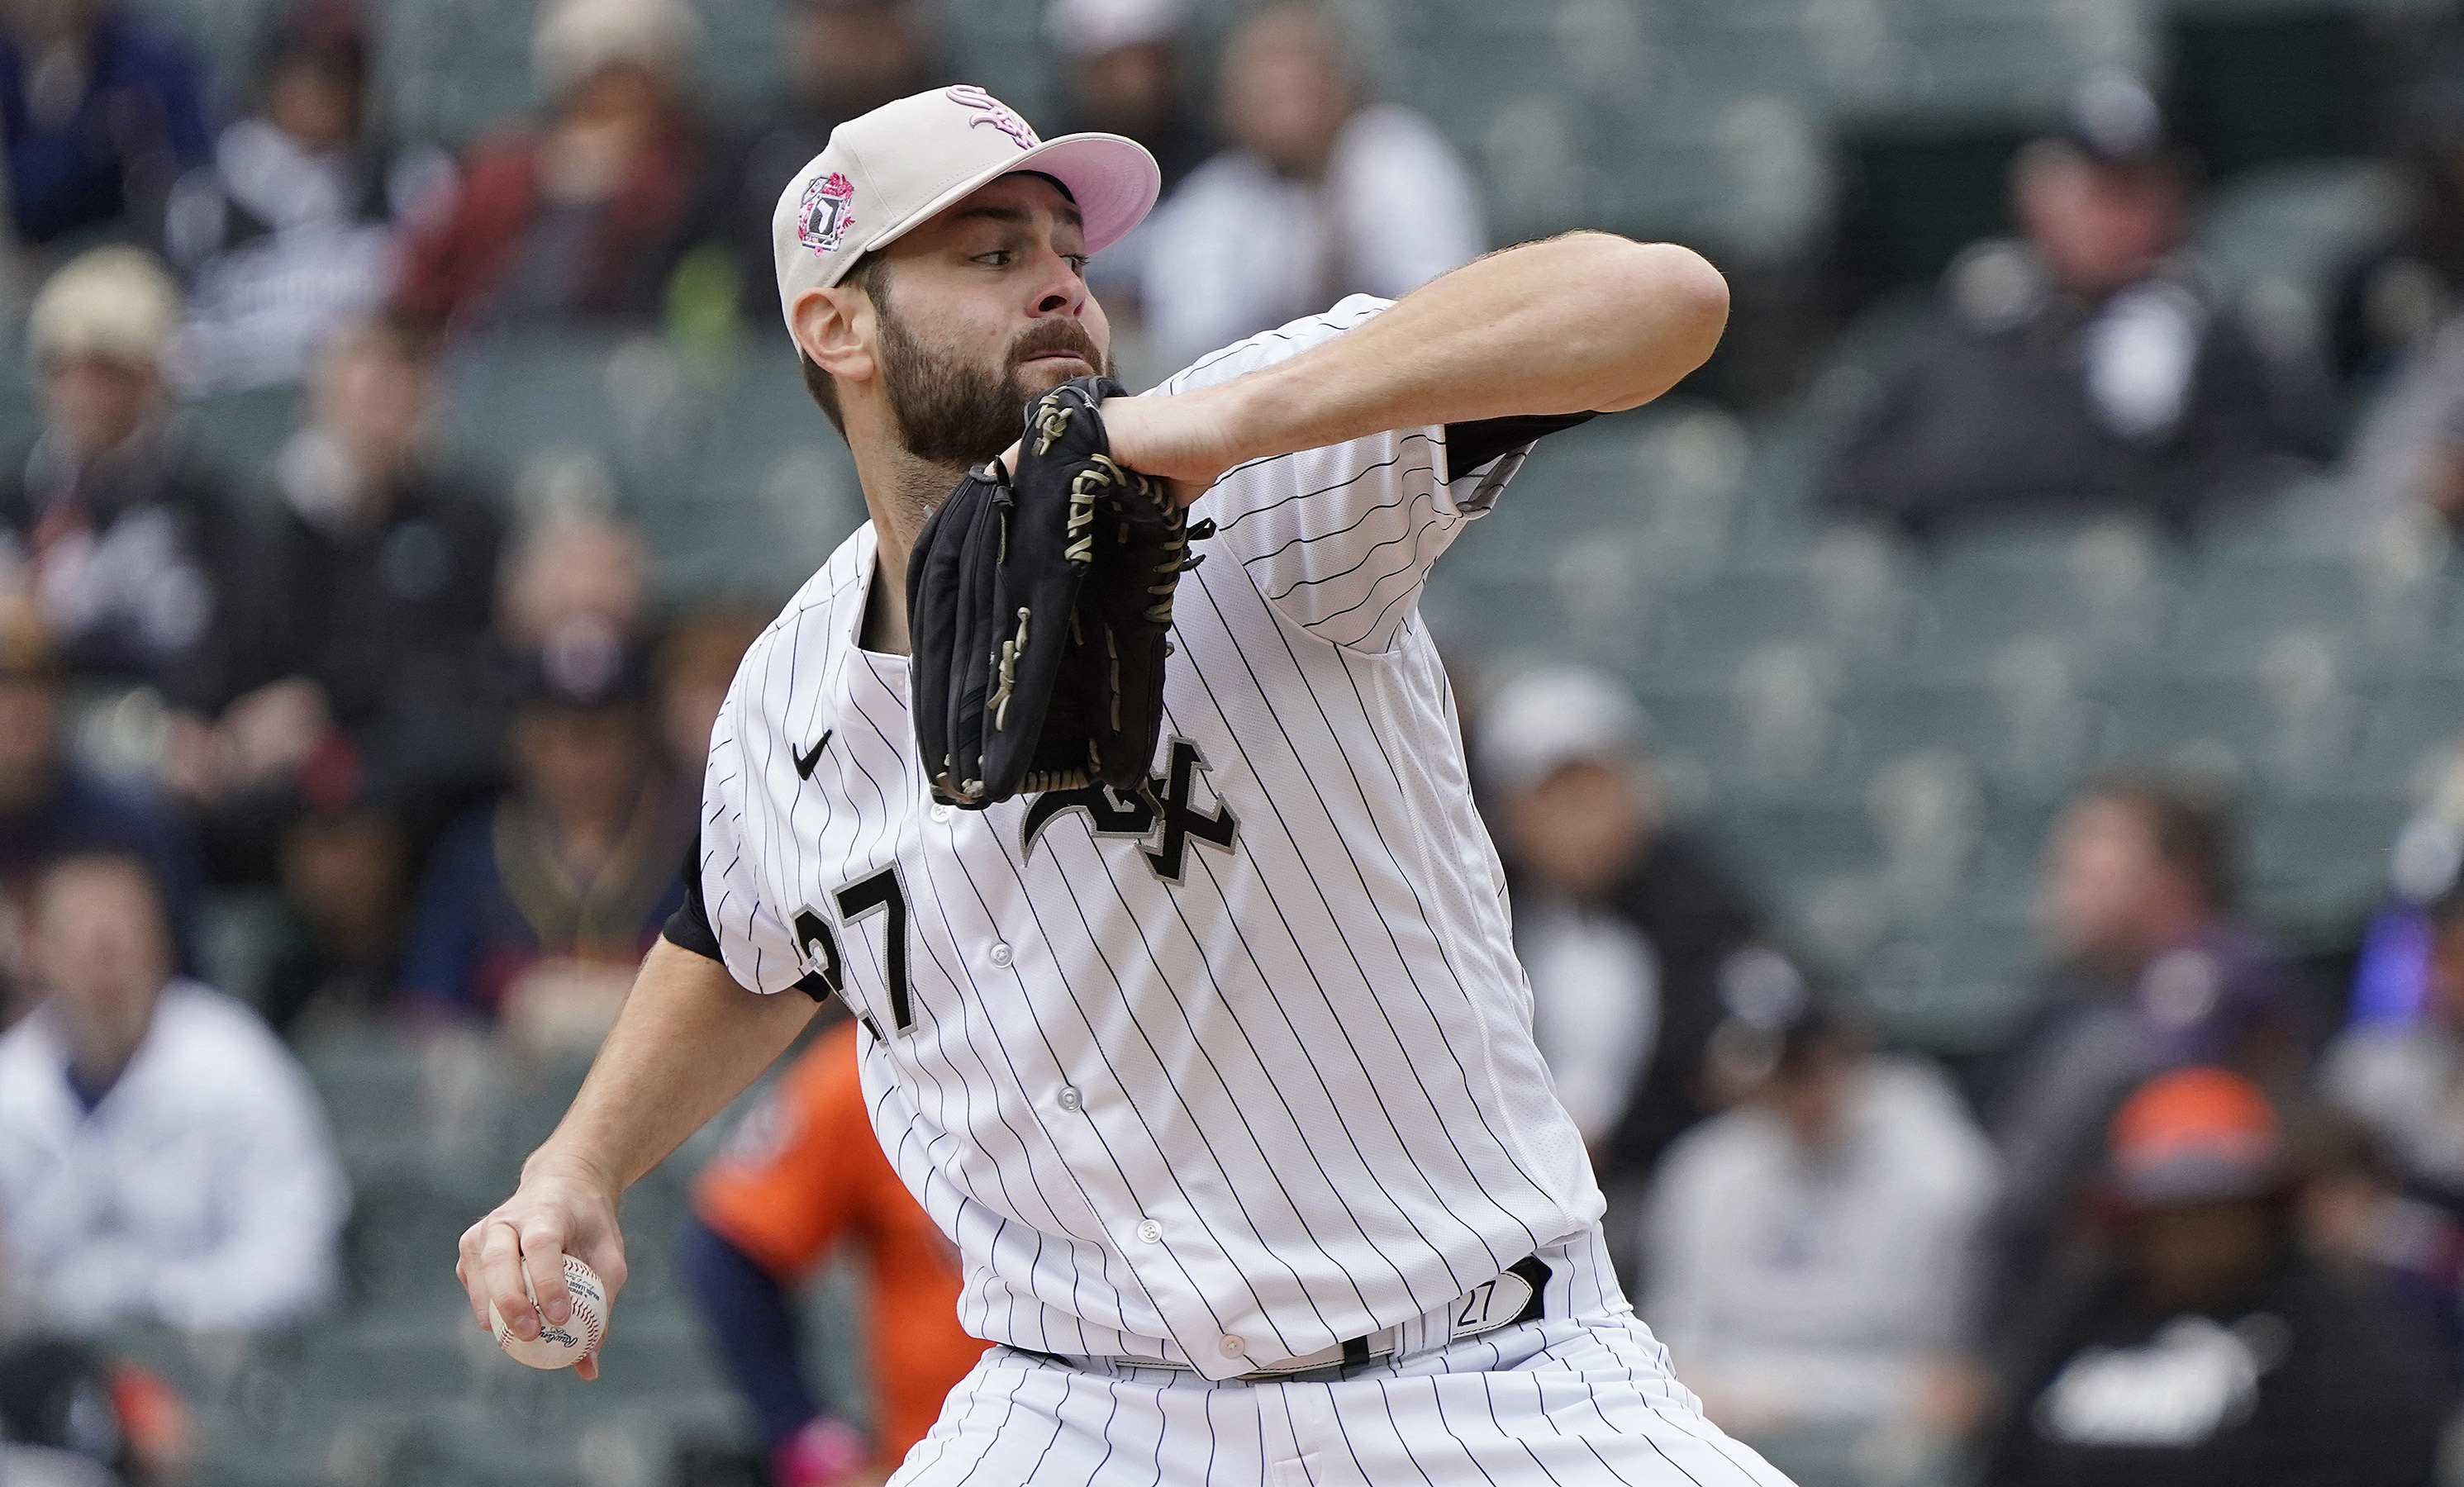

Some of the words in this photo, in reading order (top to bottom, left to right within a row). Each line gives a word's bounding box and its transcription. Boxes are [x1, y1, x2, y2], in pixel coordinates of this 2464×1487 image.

[790, 858, 919, 1049] 27
[1457, 1279, 1496, 1328] 27
[539, 1325, 578, 1348] Rawlin
